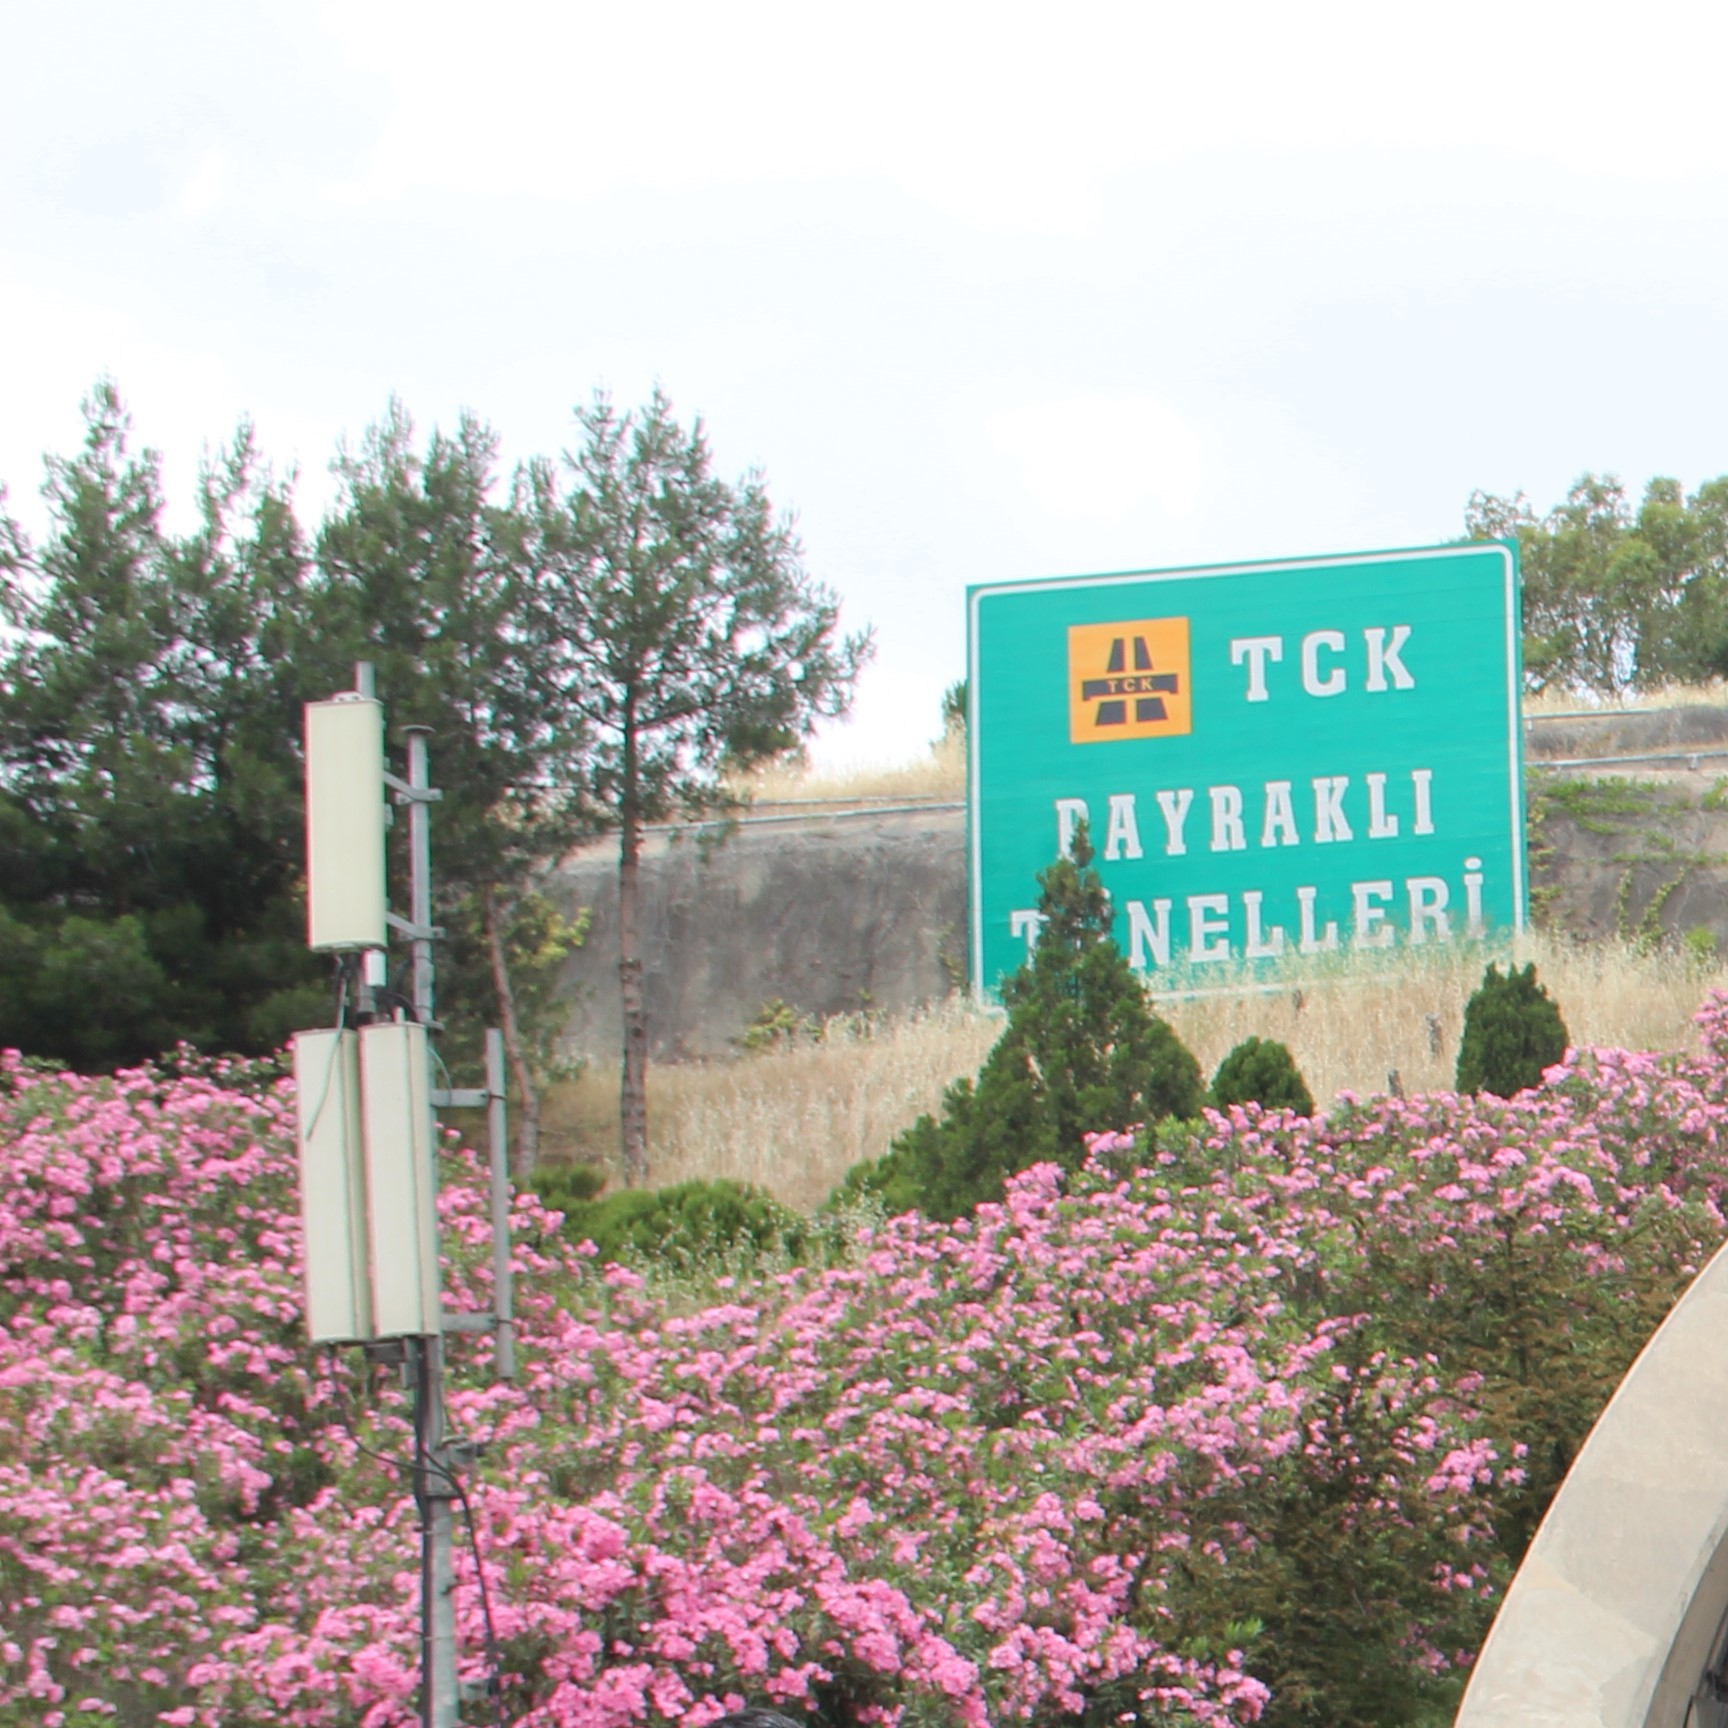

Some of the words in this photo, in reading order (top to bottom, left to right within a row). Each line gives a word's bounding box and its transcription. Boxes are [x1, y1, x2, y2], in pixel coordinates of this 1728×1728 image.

[1107, 677, 1153, 693] TCK
[1230, 625, 1415, 702] TCK
[1009, 857, 1484, 970] TNELLERİ
